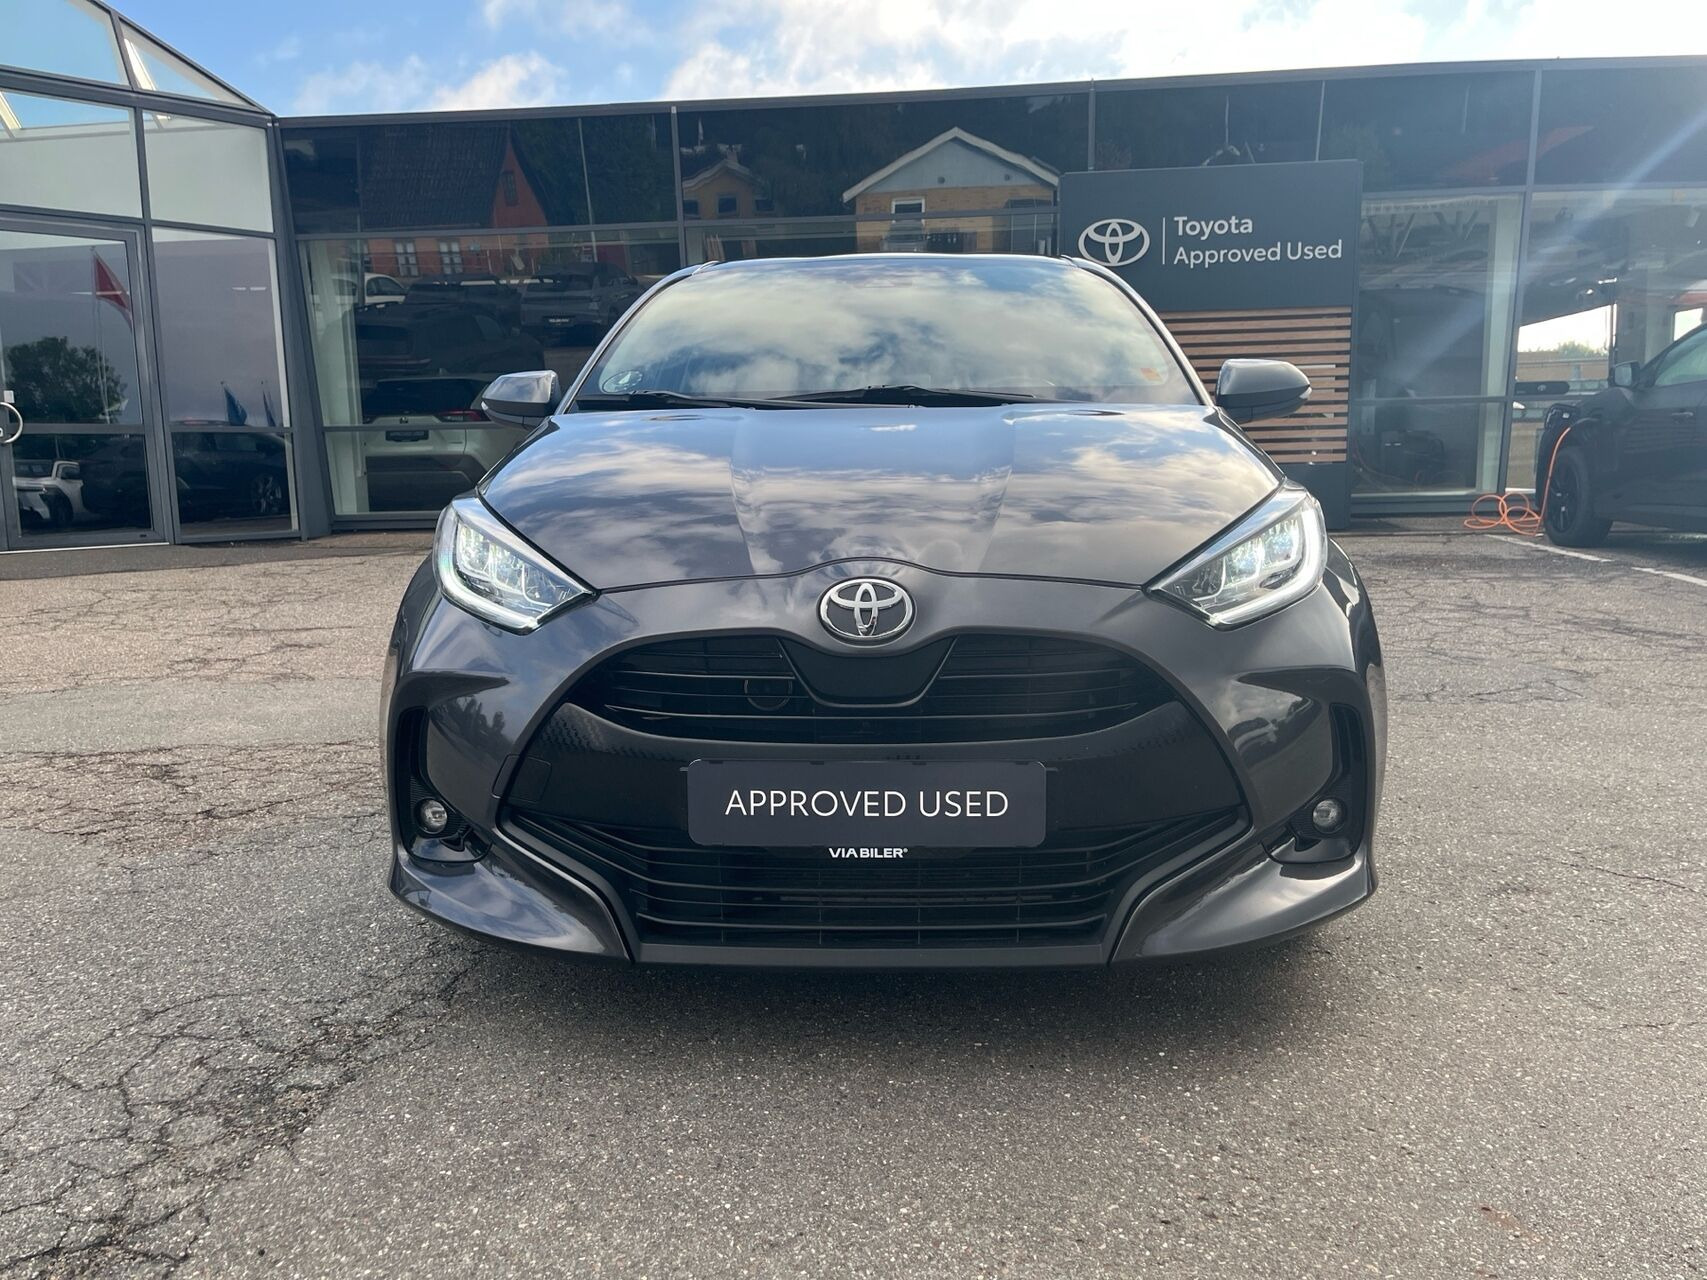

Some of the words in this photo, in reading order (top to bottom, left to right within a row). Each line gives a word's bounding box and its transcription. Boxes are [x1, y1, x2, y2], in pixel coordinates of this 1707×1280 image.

[1173, 215, 1253, 241] Toyota
[1173, 241, 1281, 269] Approved
[1286, 238, 1343, 261] Used
[724, 789, 907, 817] APPROVED
[919, 790, 1009, 818] USED
